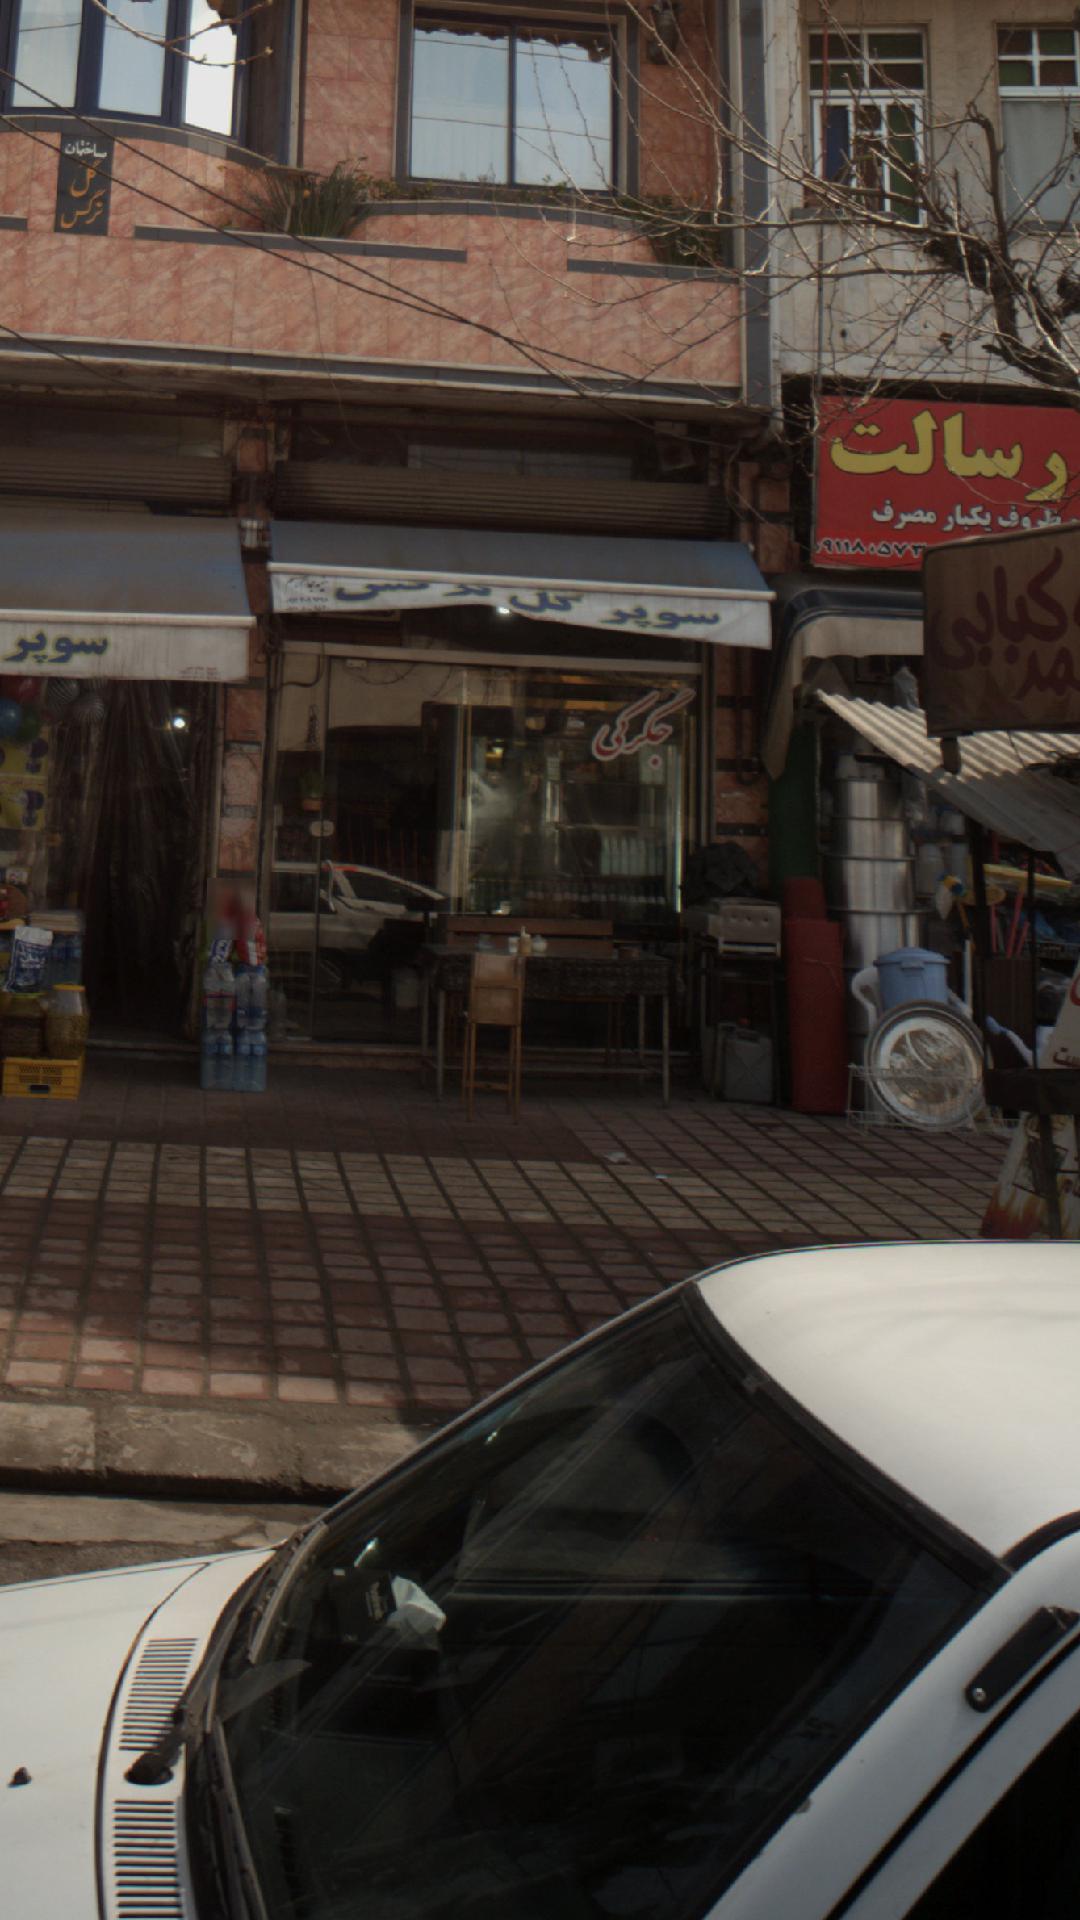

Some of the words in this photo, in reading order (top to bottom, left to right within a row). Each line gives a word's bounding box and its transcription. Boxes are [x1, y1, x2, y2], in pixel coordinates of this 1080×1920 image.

[64, 140, 108, 158] ساختمان
[830, 409, 1068, 502] رسالت
[872, 498, 937, 530] مصرف
[942, 504, 991, 532] یکبار
[599, 605, 720, 630] سوپر
[929, 545, 1068, 670] کبابی
[3, 630, 109, 664] سوپر
